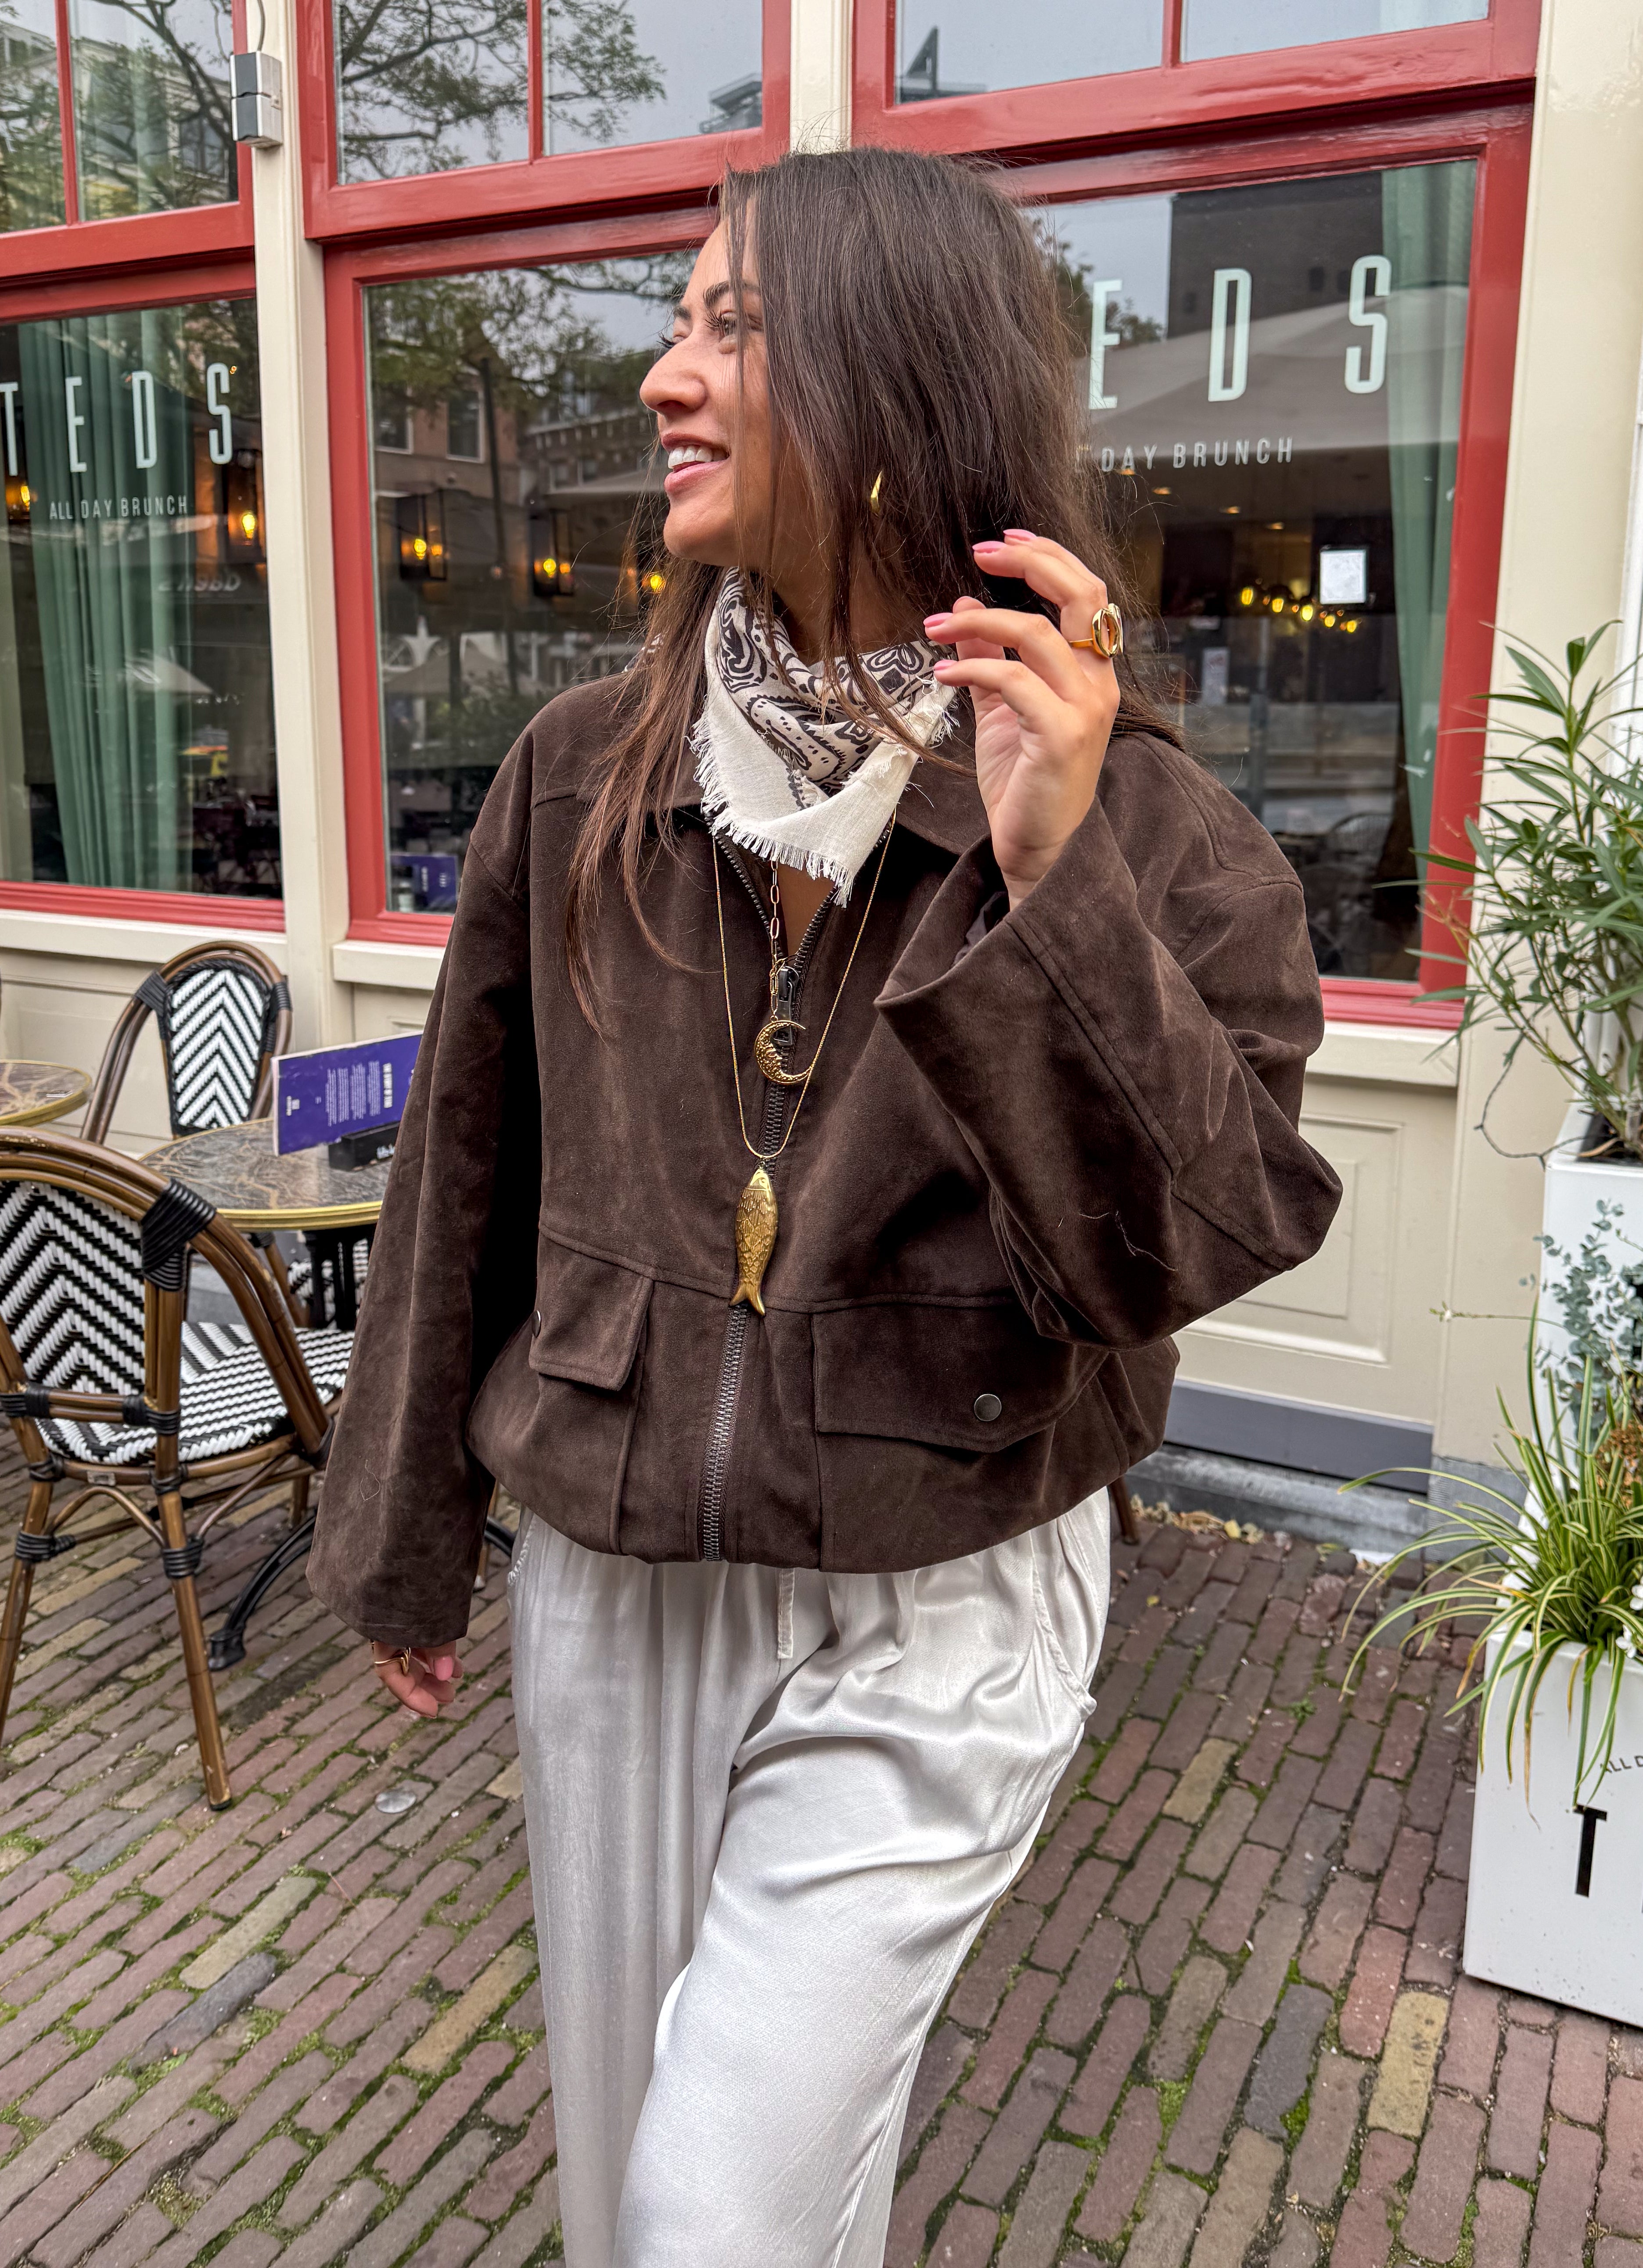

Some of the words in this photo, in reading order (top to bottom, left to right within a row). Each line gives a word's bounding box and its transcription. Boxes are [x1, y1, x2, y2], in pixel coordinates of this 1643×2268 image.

[1088, 255, 1391, 409] EDS
[0, 362, 233, 476] TEDS
[1101, 443, 1158, 473] DAY
[1173, 436, 1293, 469] BRUNCH
[49, 501, 73, 520] ALL
[81, 499, 113, 519] DAY
[120, 494, 187, 517] BRUNCH
